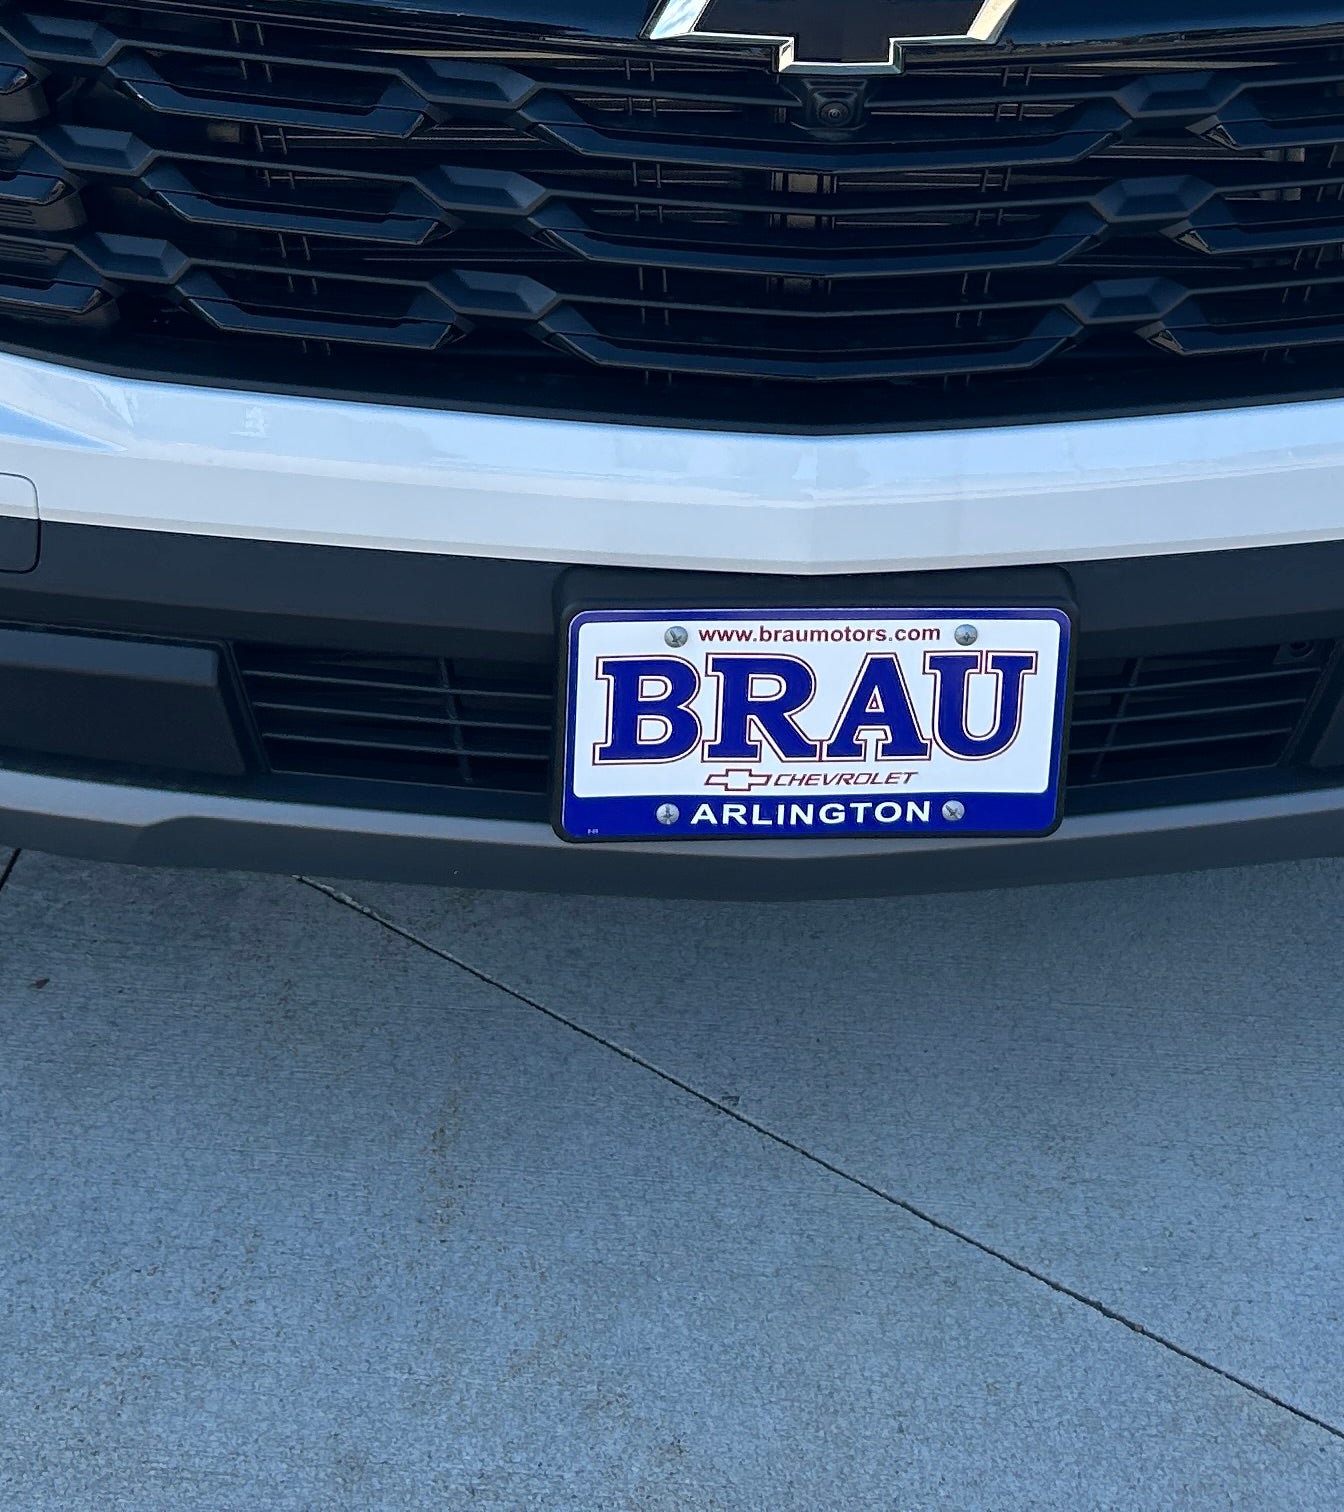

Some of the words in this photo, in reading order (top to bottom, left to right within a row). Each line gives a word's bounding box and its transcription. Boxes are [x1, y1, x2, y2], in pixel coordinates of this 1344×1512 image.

[698, 624, 941, 642] www.braumotors.com
[592, 649, 1038, 766] BRAU
[773, 771, 919, 787] CHEVROLET
[690, 800, 931, 826] ARLINGTON
